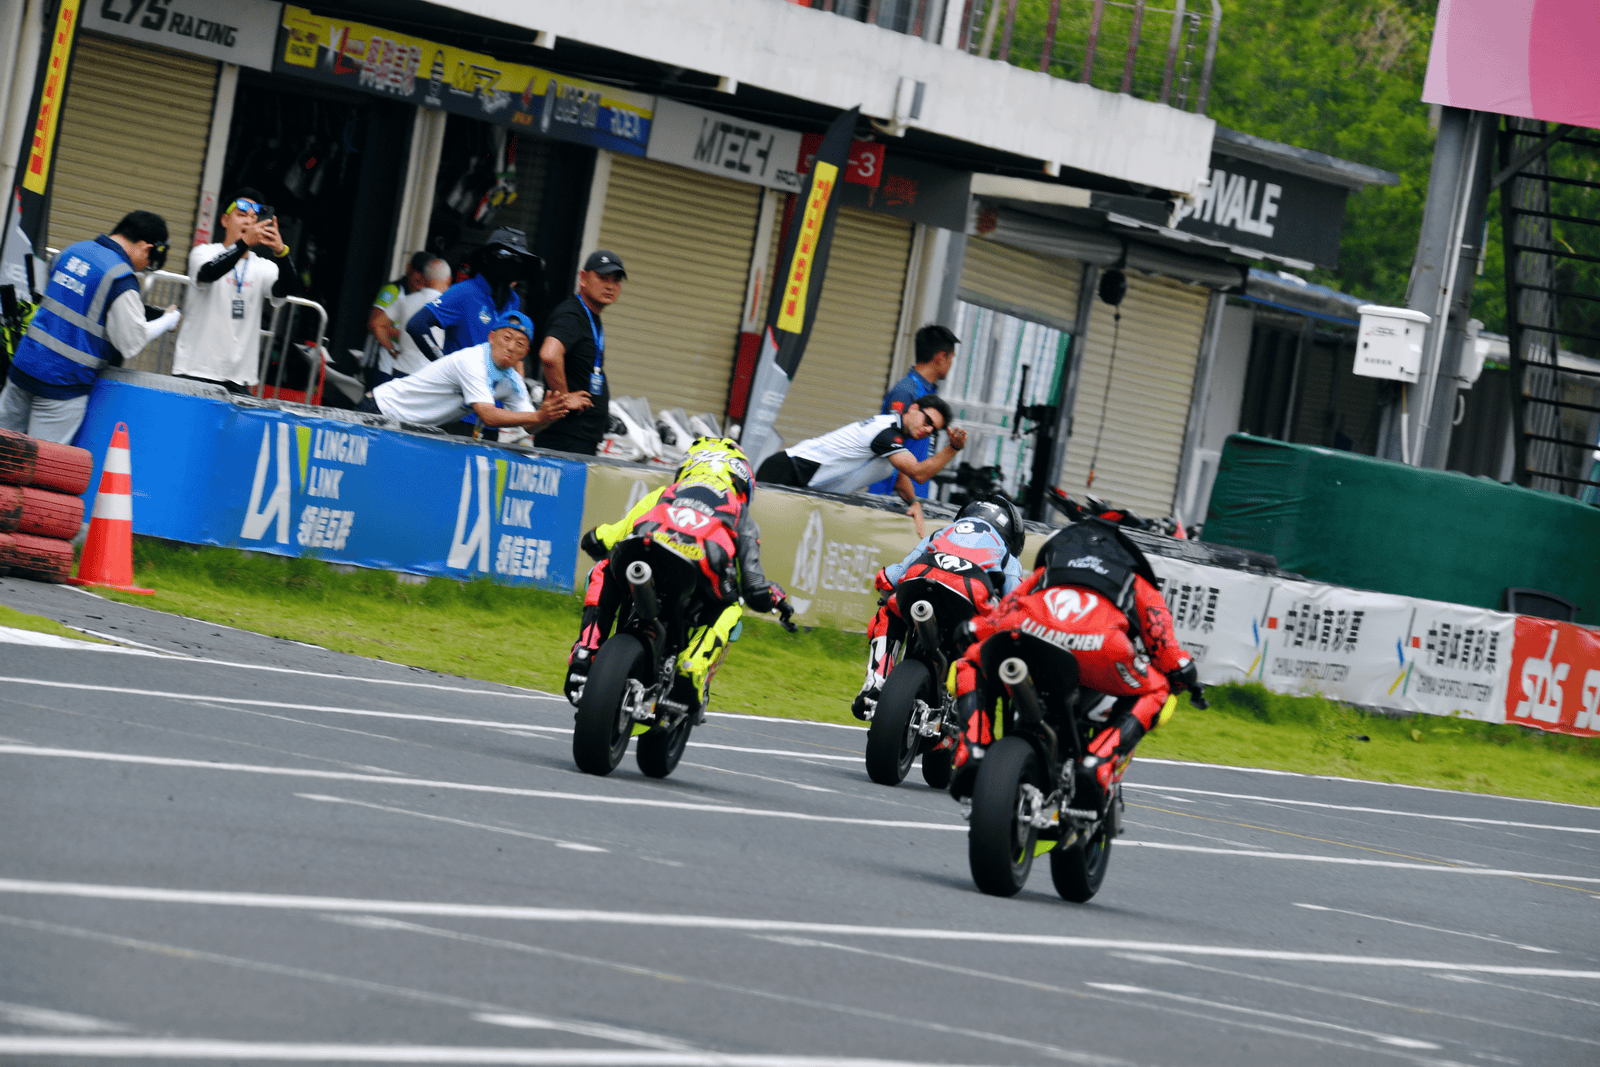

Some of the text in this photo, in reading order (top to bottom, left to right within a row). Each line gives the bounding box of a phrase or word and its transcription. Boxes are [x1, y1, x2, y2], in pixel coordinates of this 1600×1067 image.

[168, 11, 239, 48] RACING
[313, 428, 368, 466] LINGXIN
[308, 466, 344, 500] LINK
[508, 461, 562, 497] LINGXIN
[502, 496, 534, 529] LINK
